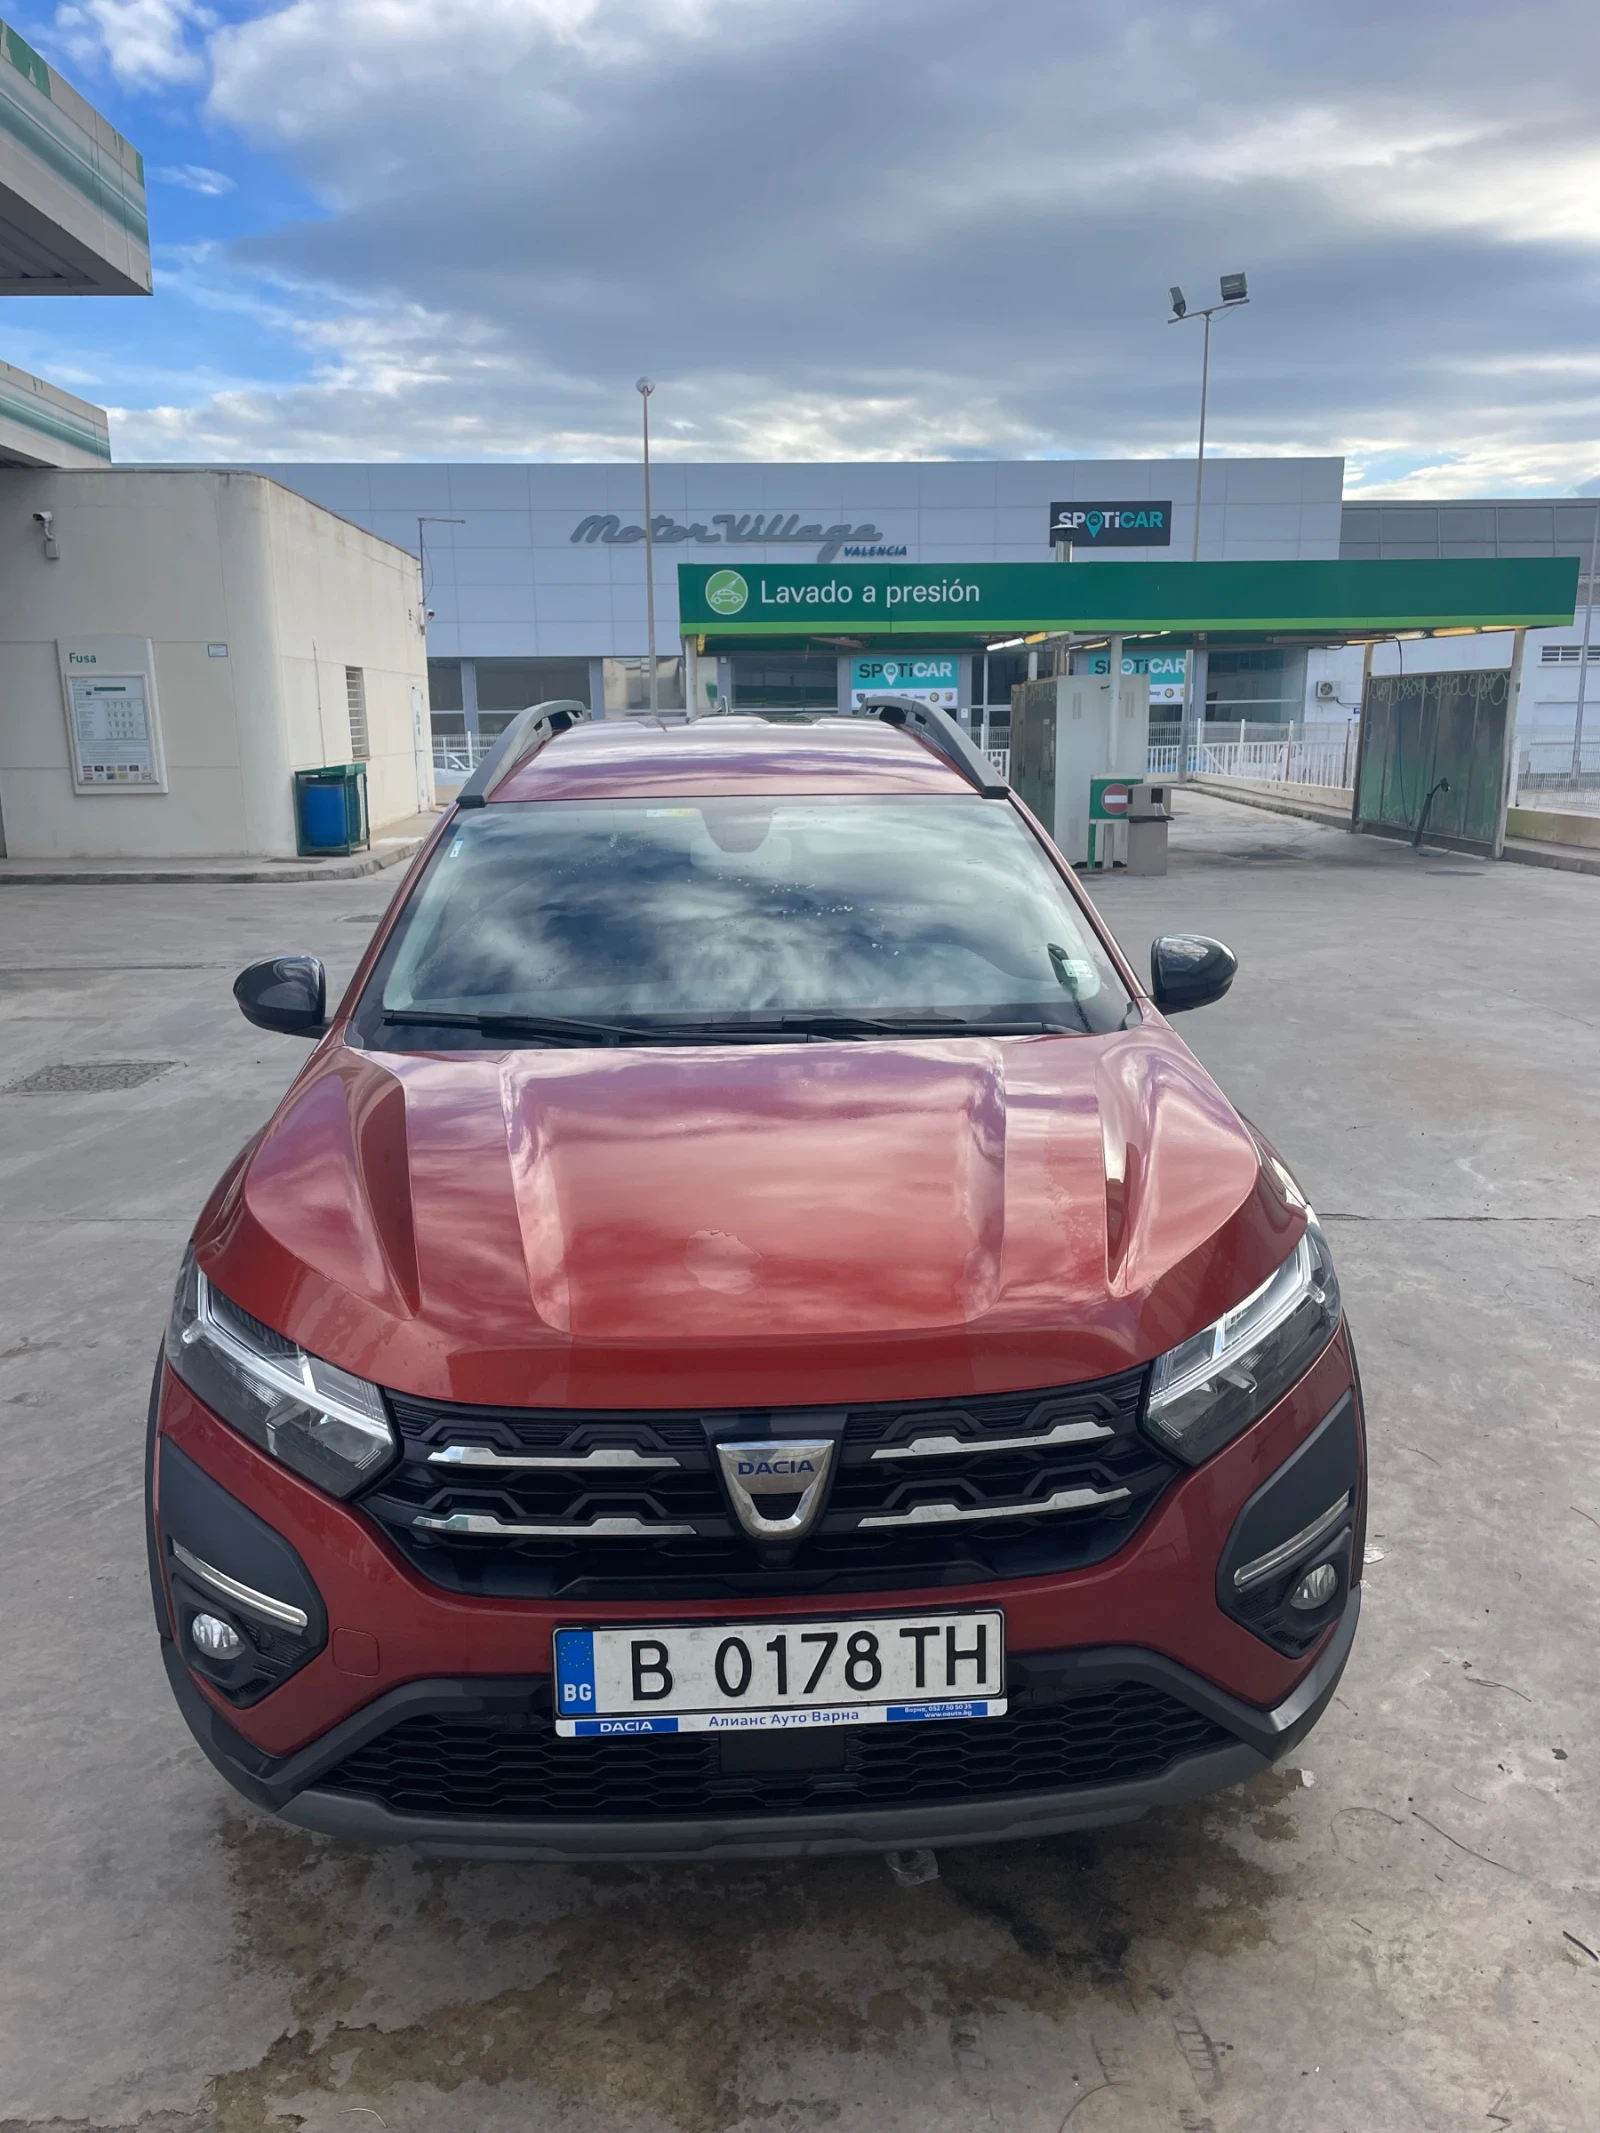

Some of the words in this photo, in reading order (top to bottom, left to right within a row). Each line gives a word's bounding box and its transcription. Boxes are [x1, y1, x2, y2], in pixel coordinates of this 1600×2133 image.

[569, 514, 722, 543] Motor
[712, 514, 883, 564] Village
[843, 545, 907, 557] VALENCIA
[761, 580, 853, 603] Lavado
[862, 587, 876, 603] a
[886, 578, 980, 609] presión
[69, 652, 97, 664] Fusa
[738, 1460, 815, 1475] DACIA
[630, 1640, 674, 1701] B
[714, 1630, 882, 1697] 0178
[900, 1624, 988, 1688] TH
[563, 1683, 592, 1702] BG
[600, 1720, 653, 1732] DACIA
[708, 1714, 766, 1727] Алианс
[771, 1713, 807, 1726] Ауто
[811, 1710, 859, 1723] Варна
